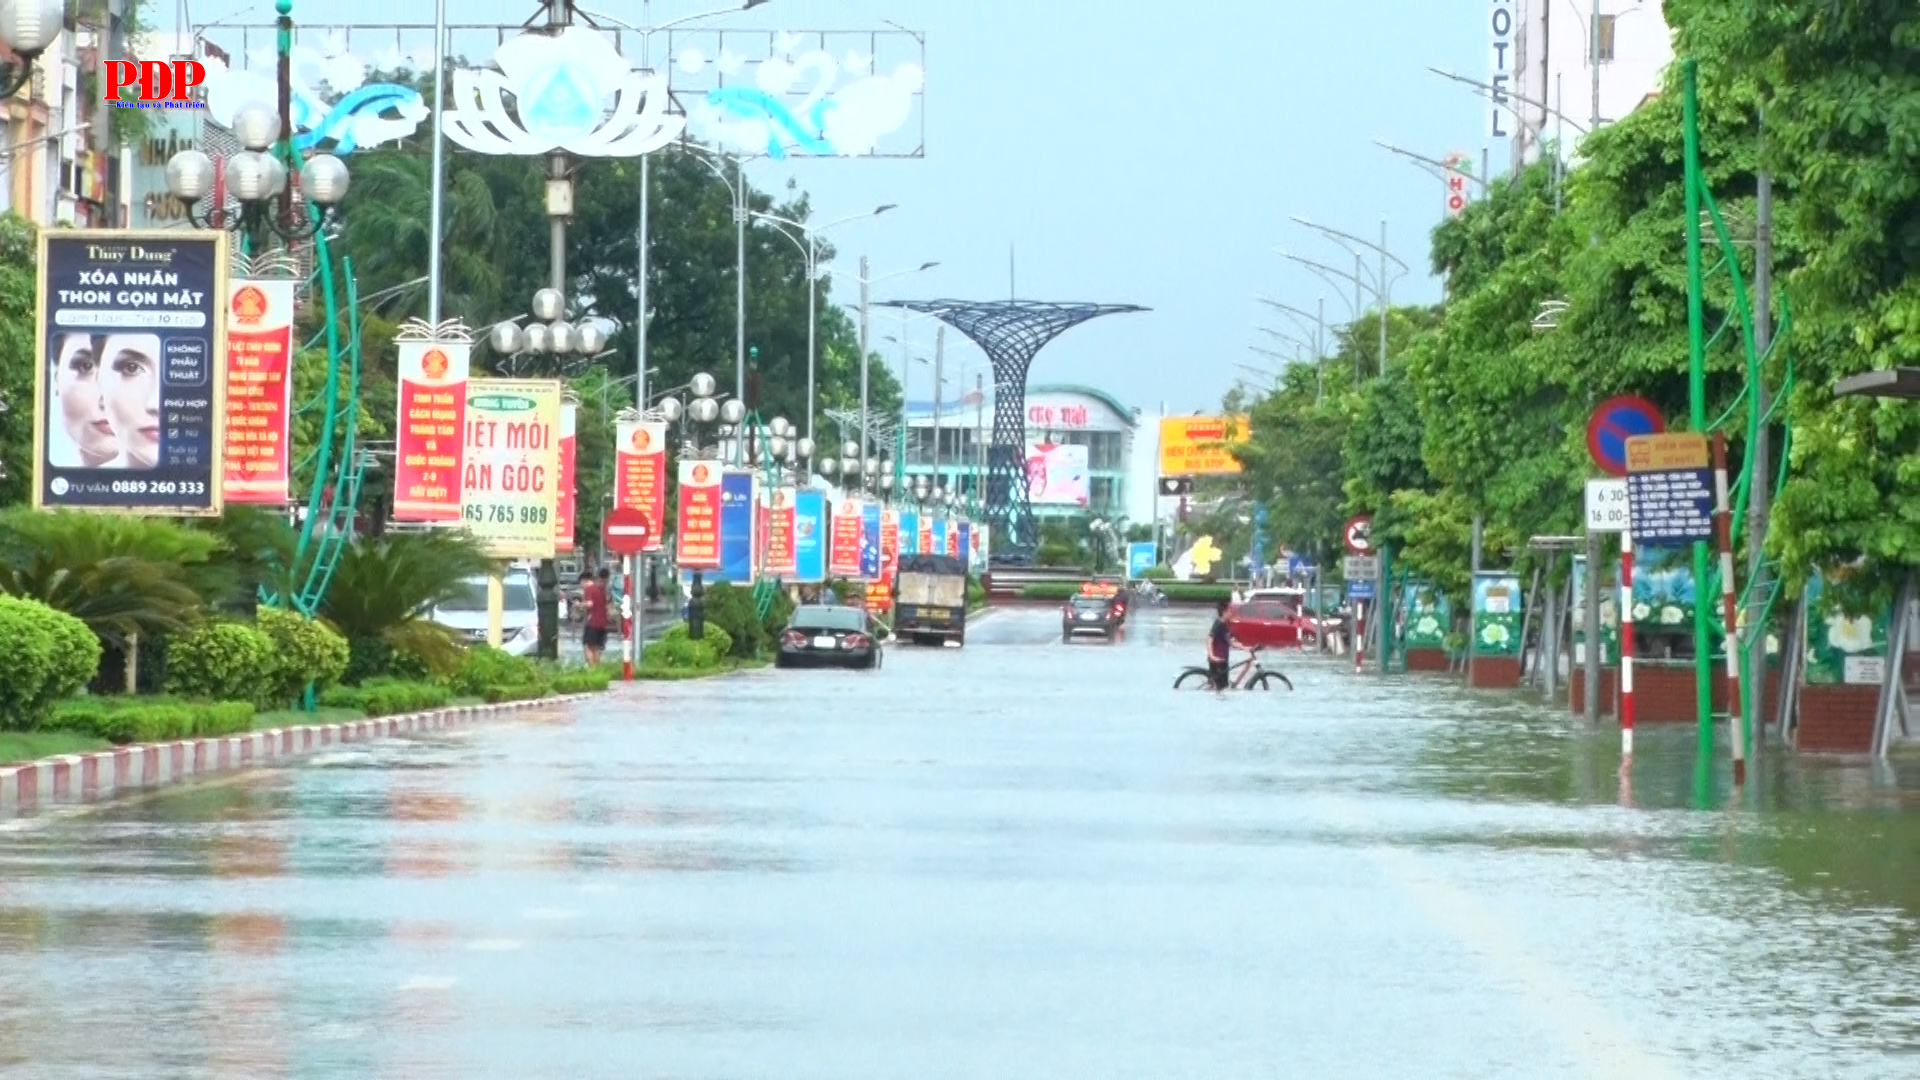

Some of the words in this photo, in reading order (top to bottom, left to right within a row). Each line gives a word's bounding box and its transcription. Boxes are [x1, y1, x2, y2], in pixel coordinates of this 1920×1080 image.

[1491, 0, 1511, 137] OTEL
[78, 268, 118, 285] XÓA
[124, 269, 178, 286] NHĂN
[58, 290, 111, 304] THON
[117, 291, 157, 307] GỌN
[164, 289, 204, 308] MẶT
[467, 414, 498, 454] IỆT
[465, 456, 491, 496] ẬN
[502, 455, 544, 491] GỐC
[112, 480, 147, 493] 0889
[150, 480, 176, 494] 260
[179, 481, 204, 495] 333
[461, 504, 482, 522] 65
